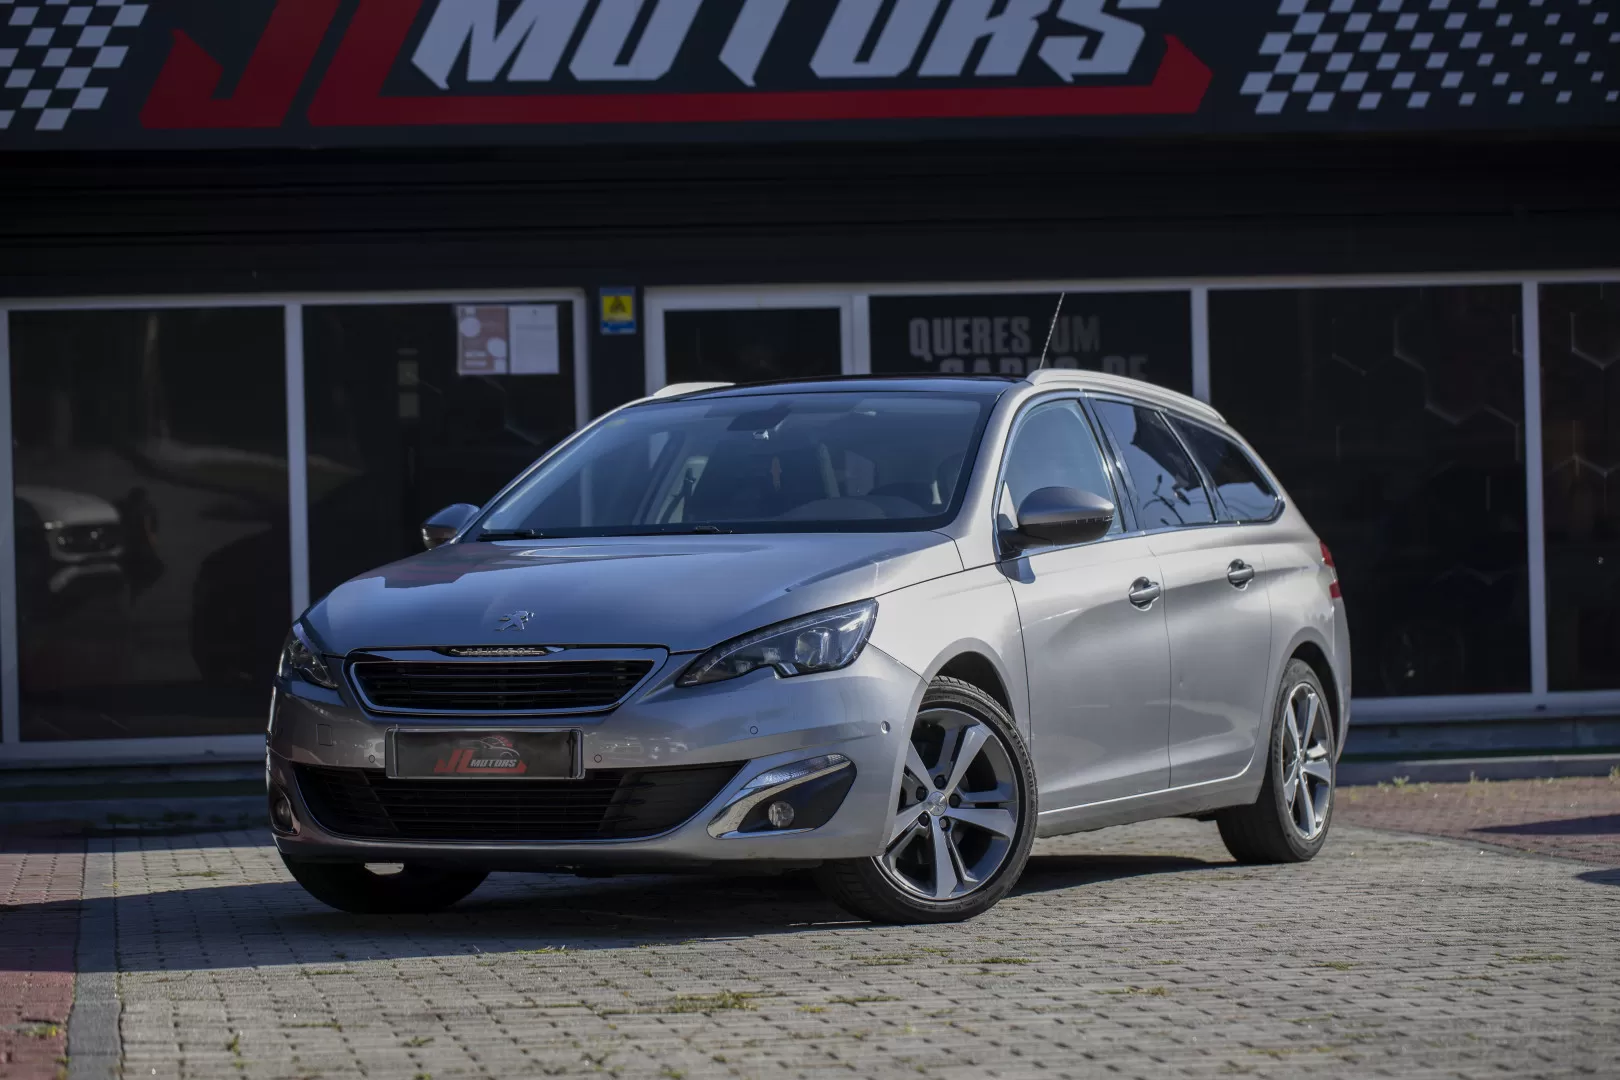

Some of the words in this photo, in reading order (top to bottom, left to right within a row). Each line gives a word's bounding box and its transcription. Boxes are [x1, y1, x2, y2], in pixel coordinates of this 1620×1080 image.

[411, 0, 1159, 88] MOTORS
[908, 316, 1032, 362] QUERES
[1051, 314, 1101, 353] UM
[469, 759, 517, 768] MOTORS
